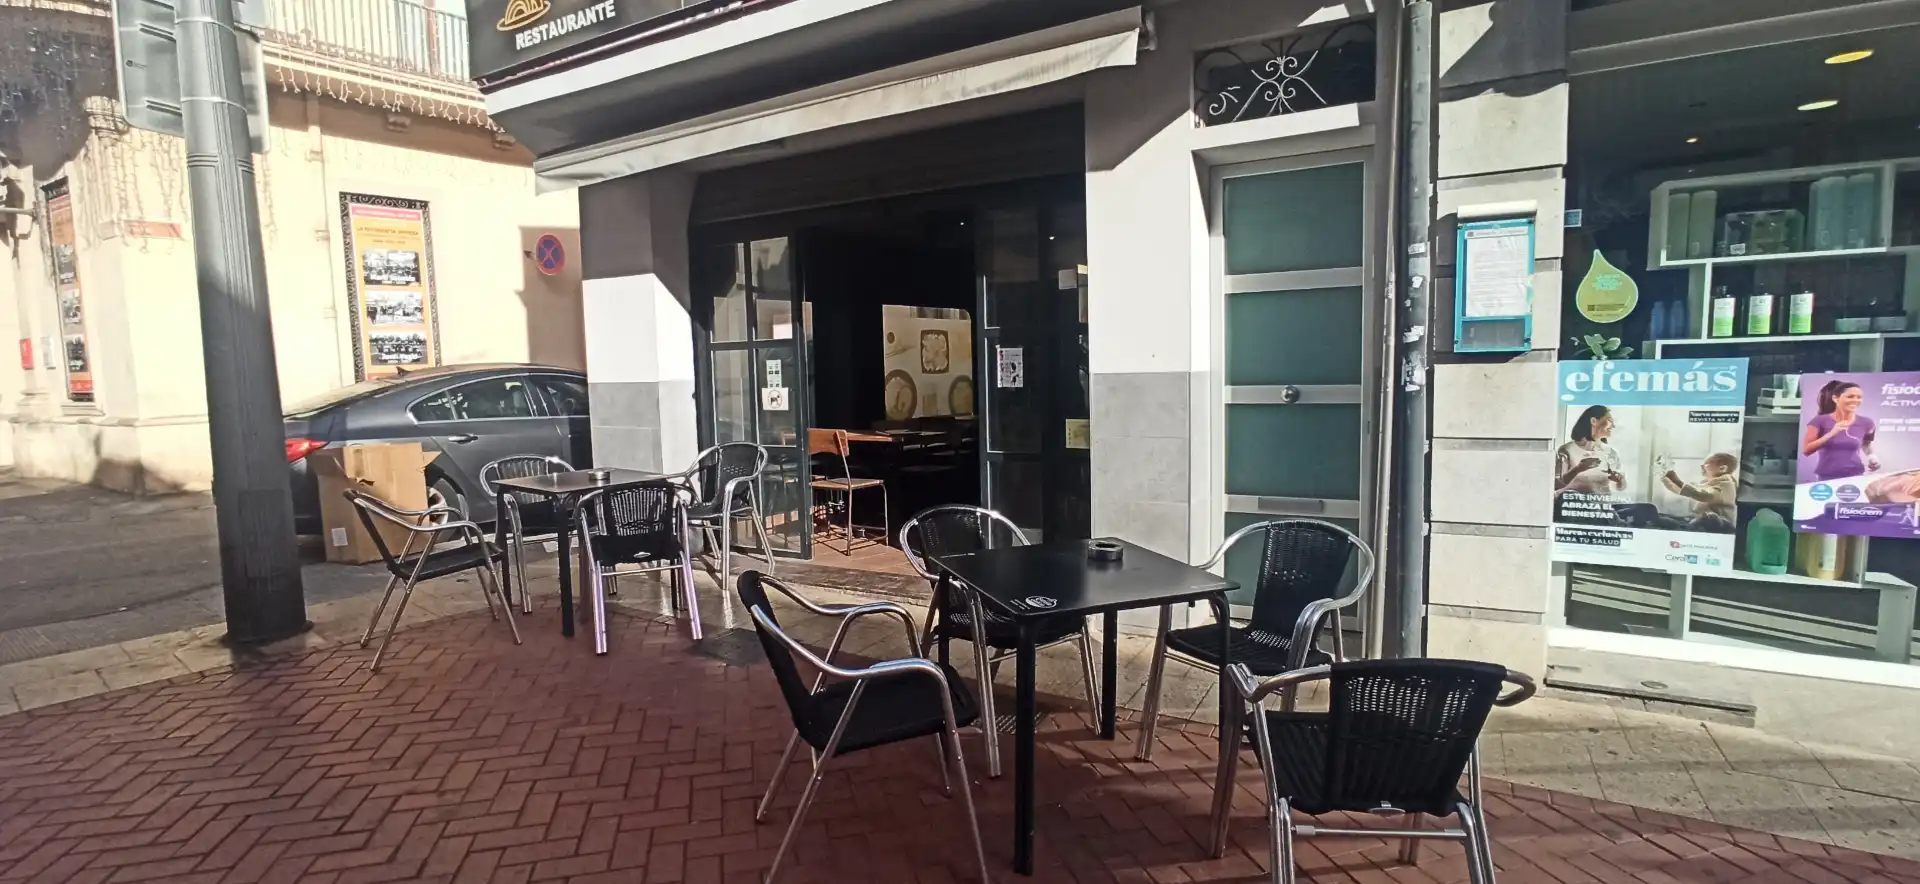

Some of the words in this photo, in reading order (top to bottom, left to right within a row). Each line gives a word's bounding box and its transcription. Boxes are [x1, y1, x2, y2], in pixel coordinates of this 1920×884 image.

[515, 0, 616, 50] RESTAURANTE
[1565, 360, 1738, 392] efemás
[1562, 493, 1586, 501] ESTE
[1561, 501, 1601, 510] ABRAZA
[1602, 503, 1615, 511] EL
[1561, 509, 1614, 519] BIENESTAR
[1839, 507, 1883, 516] fisiocrem
[1555, 527, 1587, 536] Marcas
[1587, 530, 1633, 539] exclusivas
